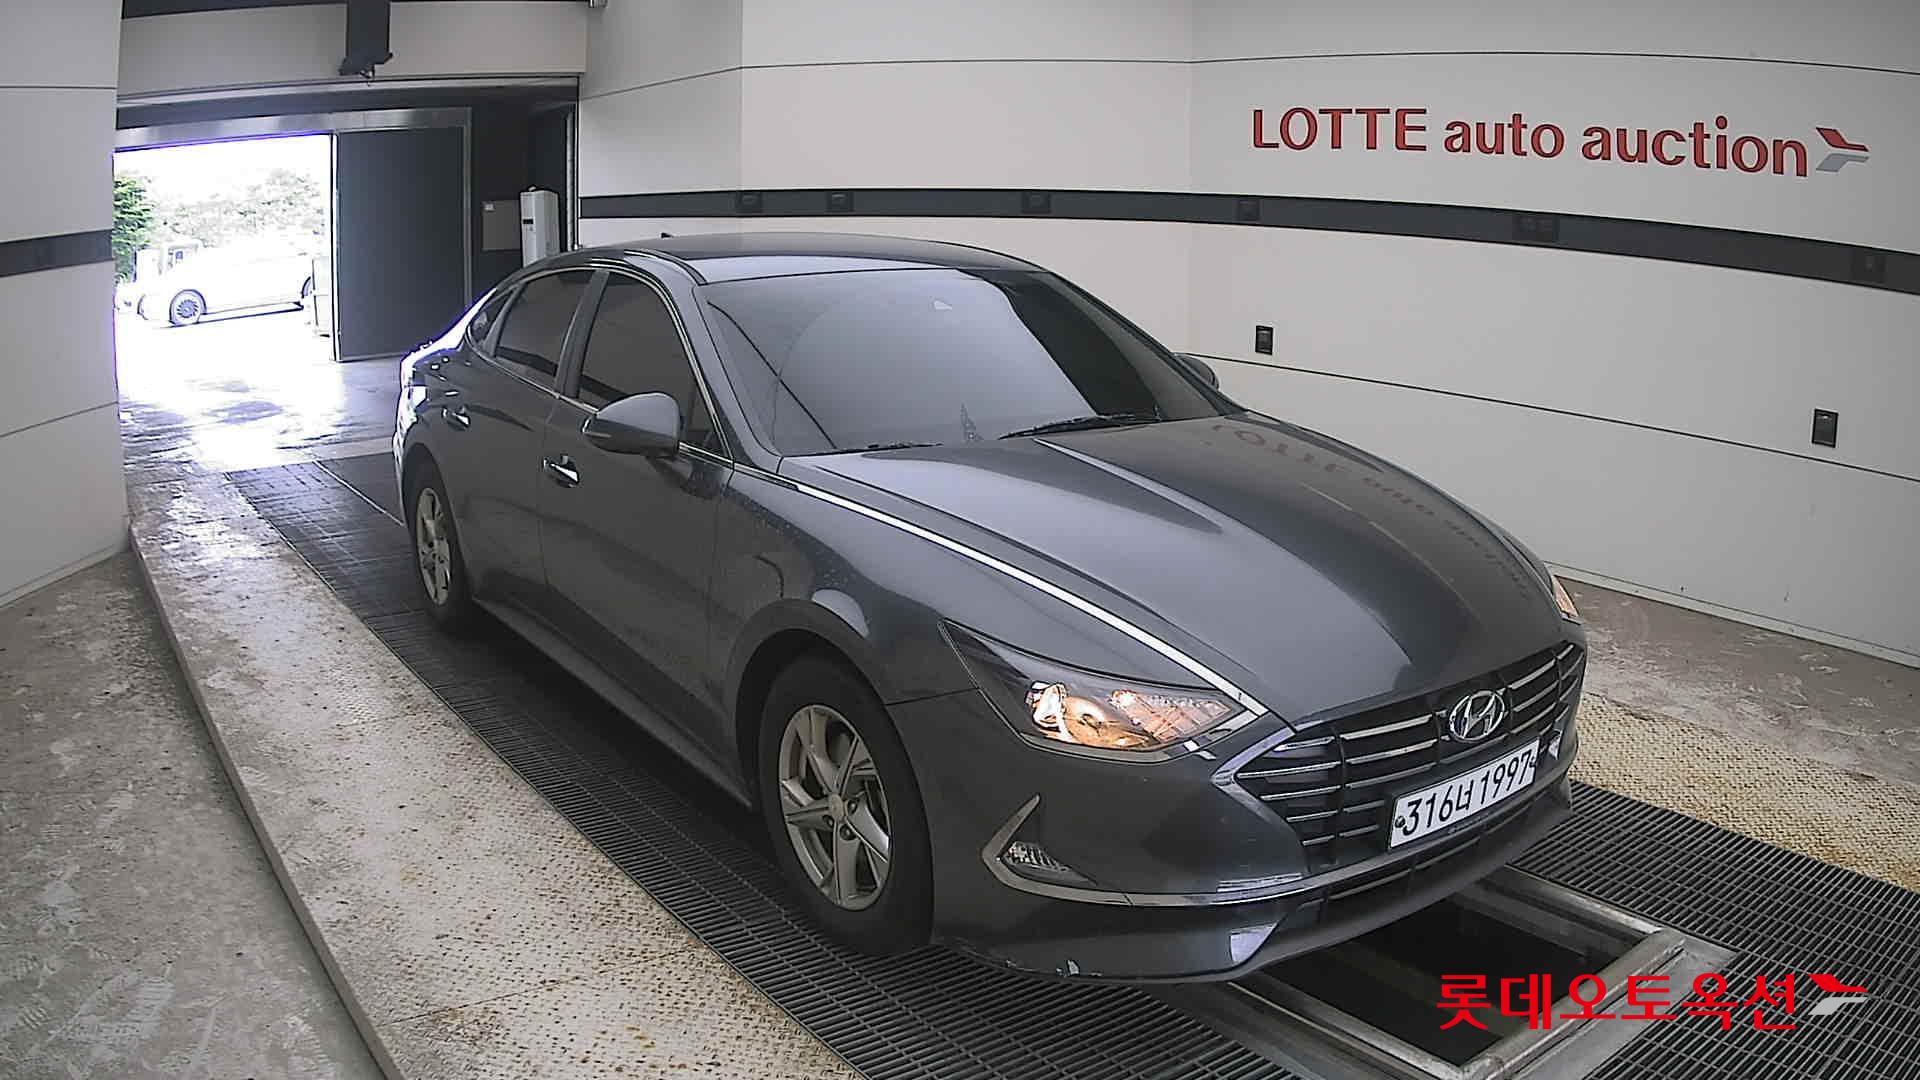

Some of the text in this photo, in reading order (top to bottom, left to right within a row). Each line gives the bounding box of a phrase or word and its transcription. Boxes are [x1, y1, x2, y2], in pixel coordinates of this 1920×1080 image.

[1254, 107, 1808, 177] LOTTE auto auction
